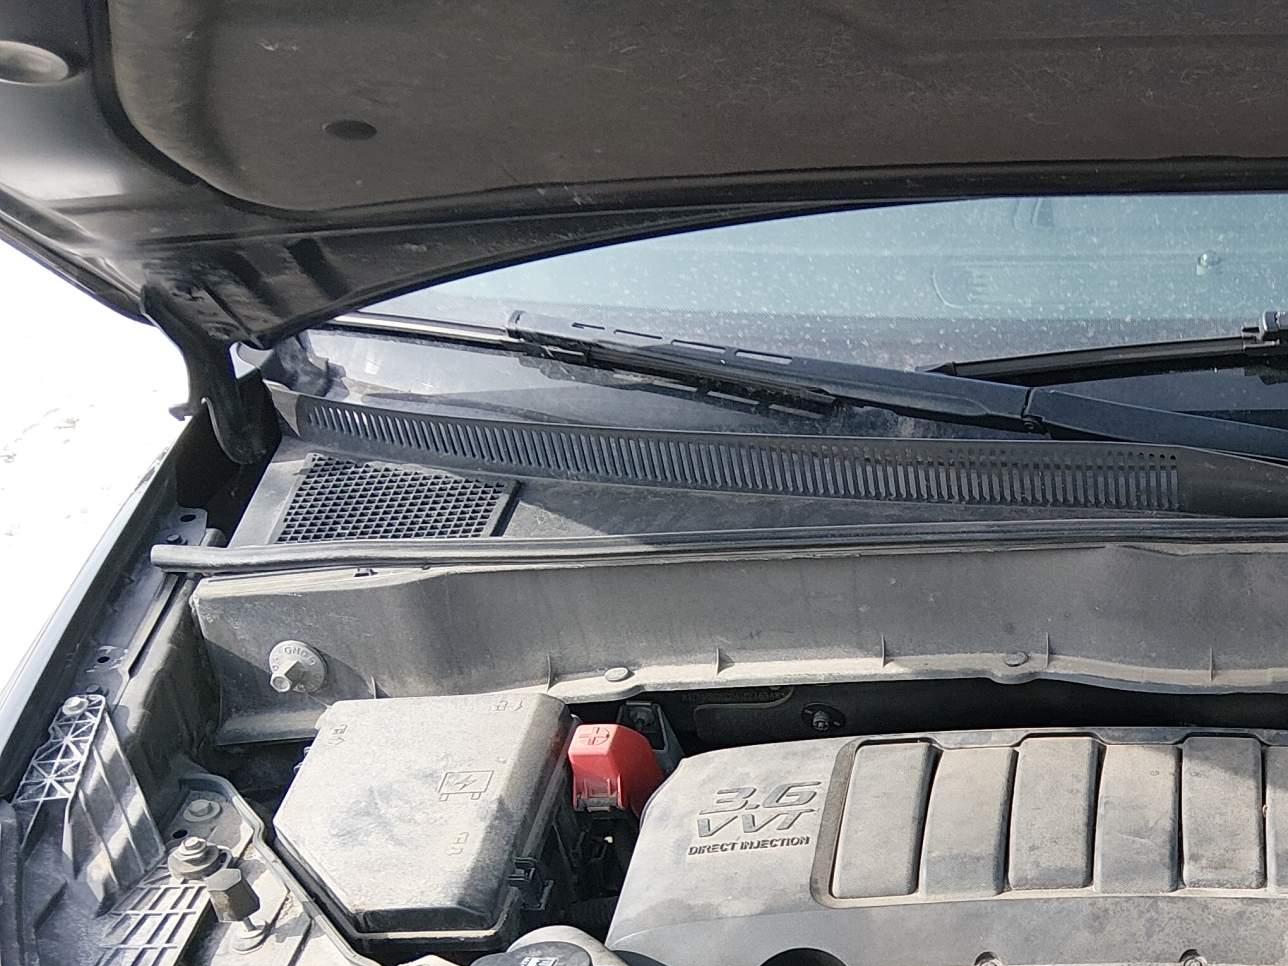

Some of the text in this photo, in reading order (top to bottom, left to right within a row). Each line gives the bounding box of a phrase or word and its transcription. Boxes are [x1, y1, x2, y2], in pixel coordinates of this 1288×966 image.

[698, 781, 822, 816] 3.6
[697, 808, 816, 838] VVT
[687, 835, 811, 856] DIRECT INJECTION
